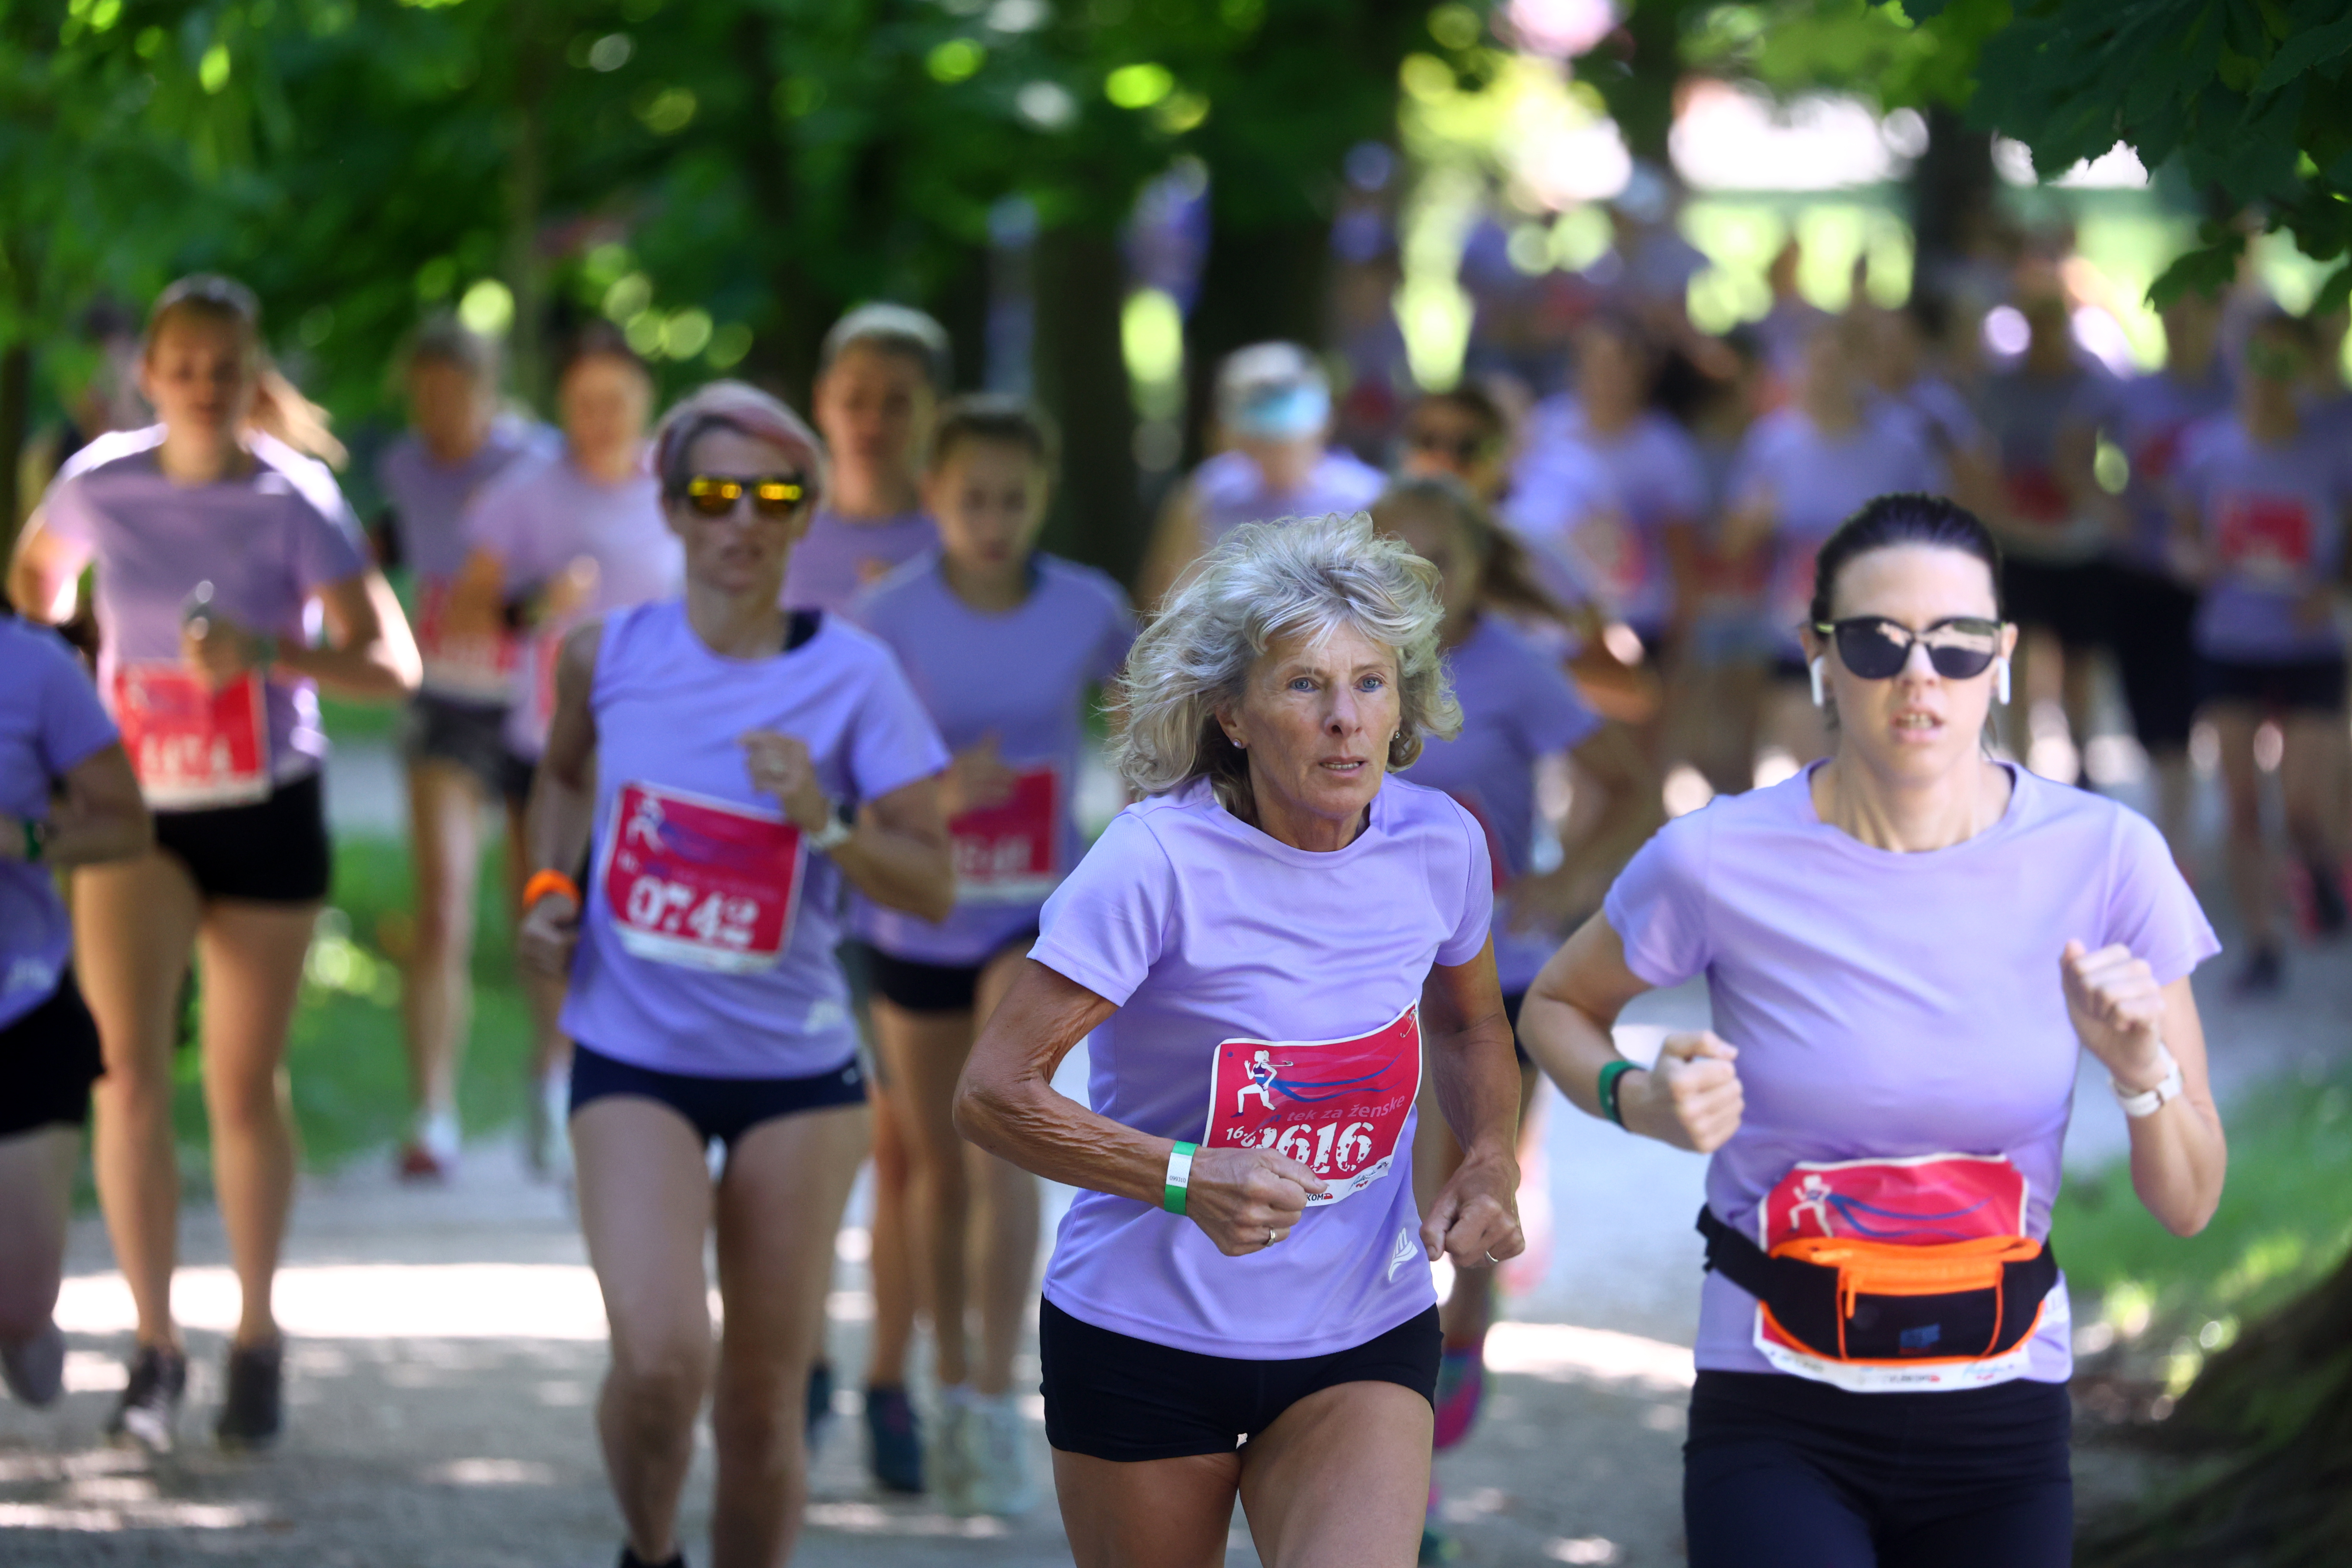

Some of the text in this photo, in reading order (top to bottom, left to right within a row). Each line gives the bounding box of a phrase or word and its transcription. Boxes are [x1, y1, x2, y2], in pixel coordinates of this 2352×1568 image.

[1286, 1110, 1317, 1121] tek
[1320, 1109, 1343, 1119] za
[1348, 1095, 1405, 1118] ženske
